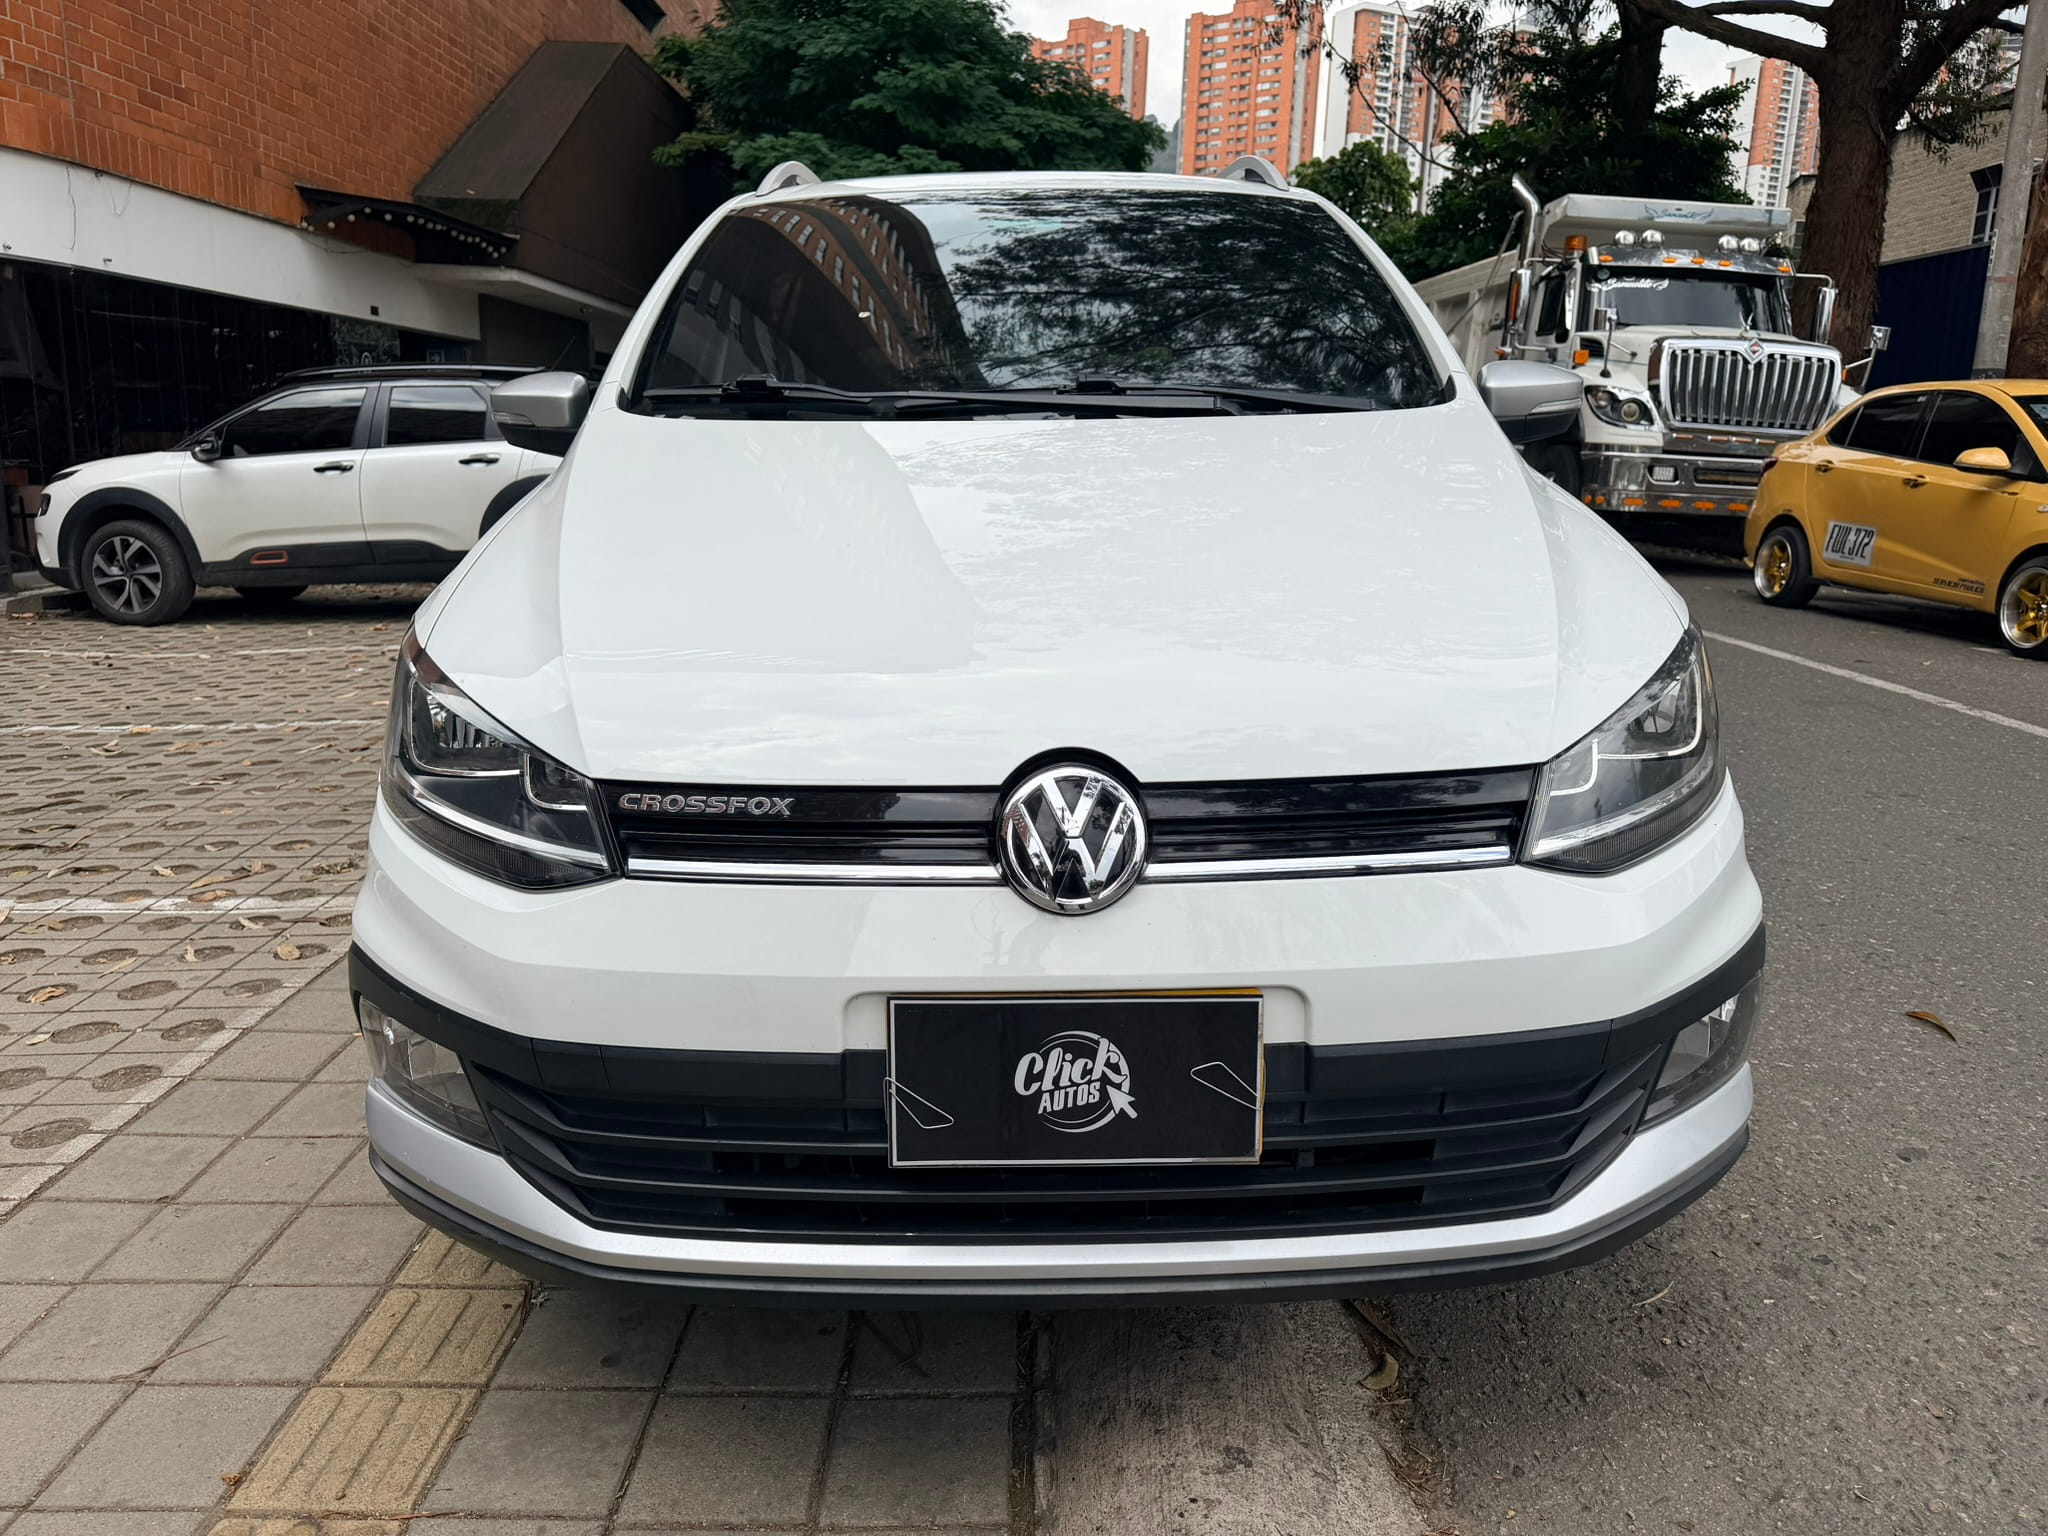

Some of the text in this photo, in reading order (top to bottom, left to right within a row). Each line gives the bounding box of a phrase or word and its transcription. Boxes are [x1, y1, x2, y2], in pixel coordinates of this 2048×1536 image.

[619, 792, 796, 817] CROSSFOX
[1014, 1037, 1128, 1096] Click
[1037, 1081, 1101, 1115] AUTOS
